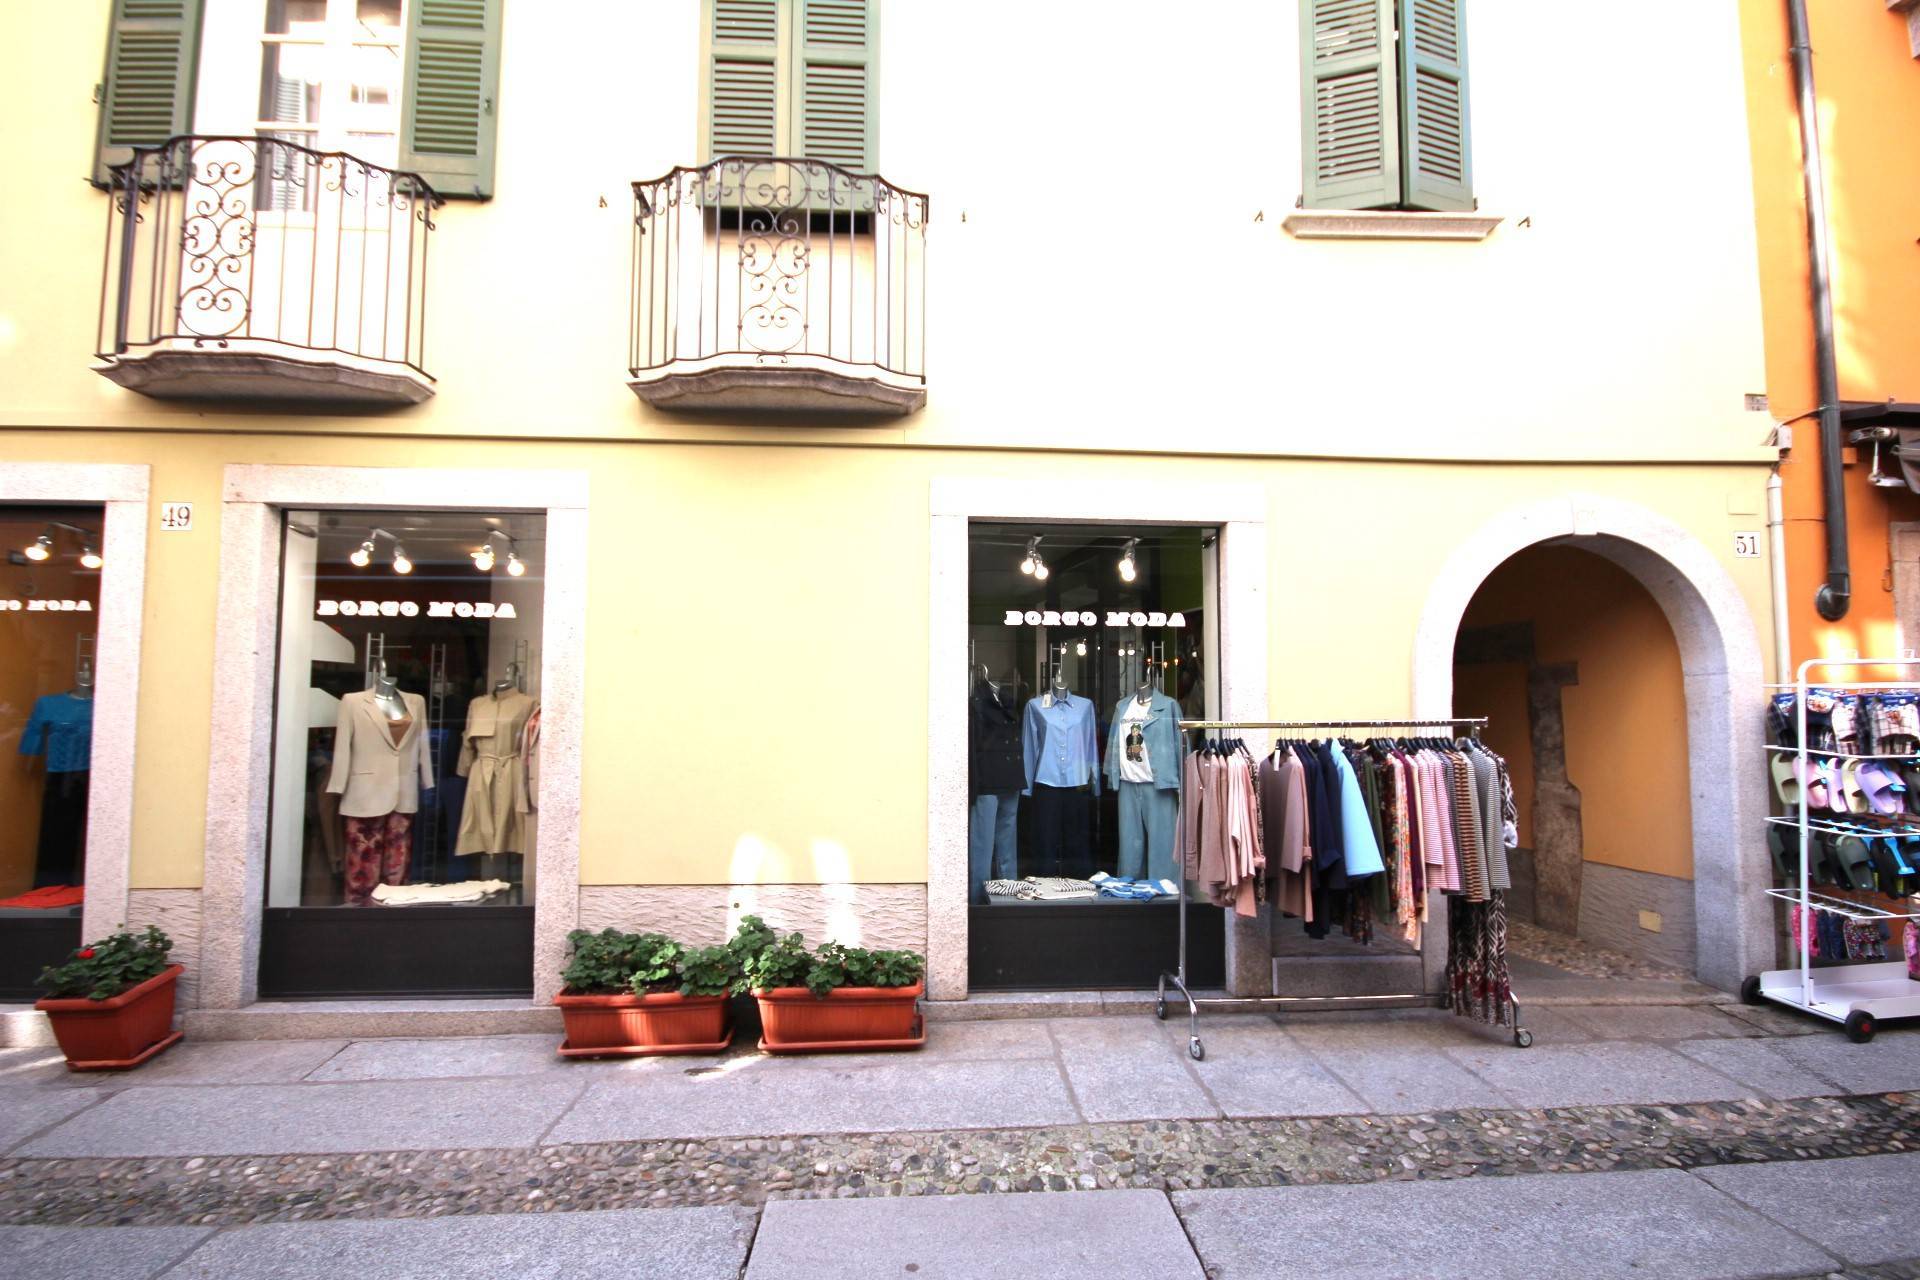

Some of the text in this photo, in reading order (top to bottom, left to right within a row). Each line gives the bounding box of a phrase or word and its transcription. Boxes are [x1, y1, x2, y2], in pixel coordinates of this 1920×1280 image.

[161, 505, 190, 527] 49
[1736, 535, 1759, 555] 51
[27, 600, 92, 611] MODA
[317, 599, 517, 618] BORGO MODA
[1004, 610, 1187, 627] BORGO MODA
